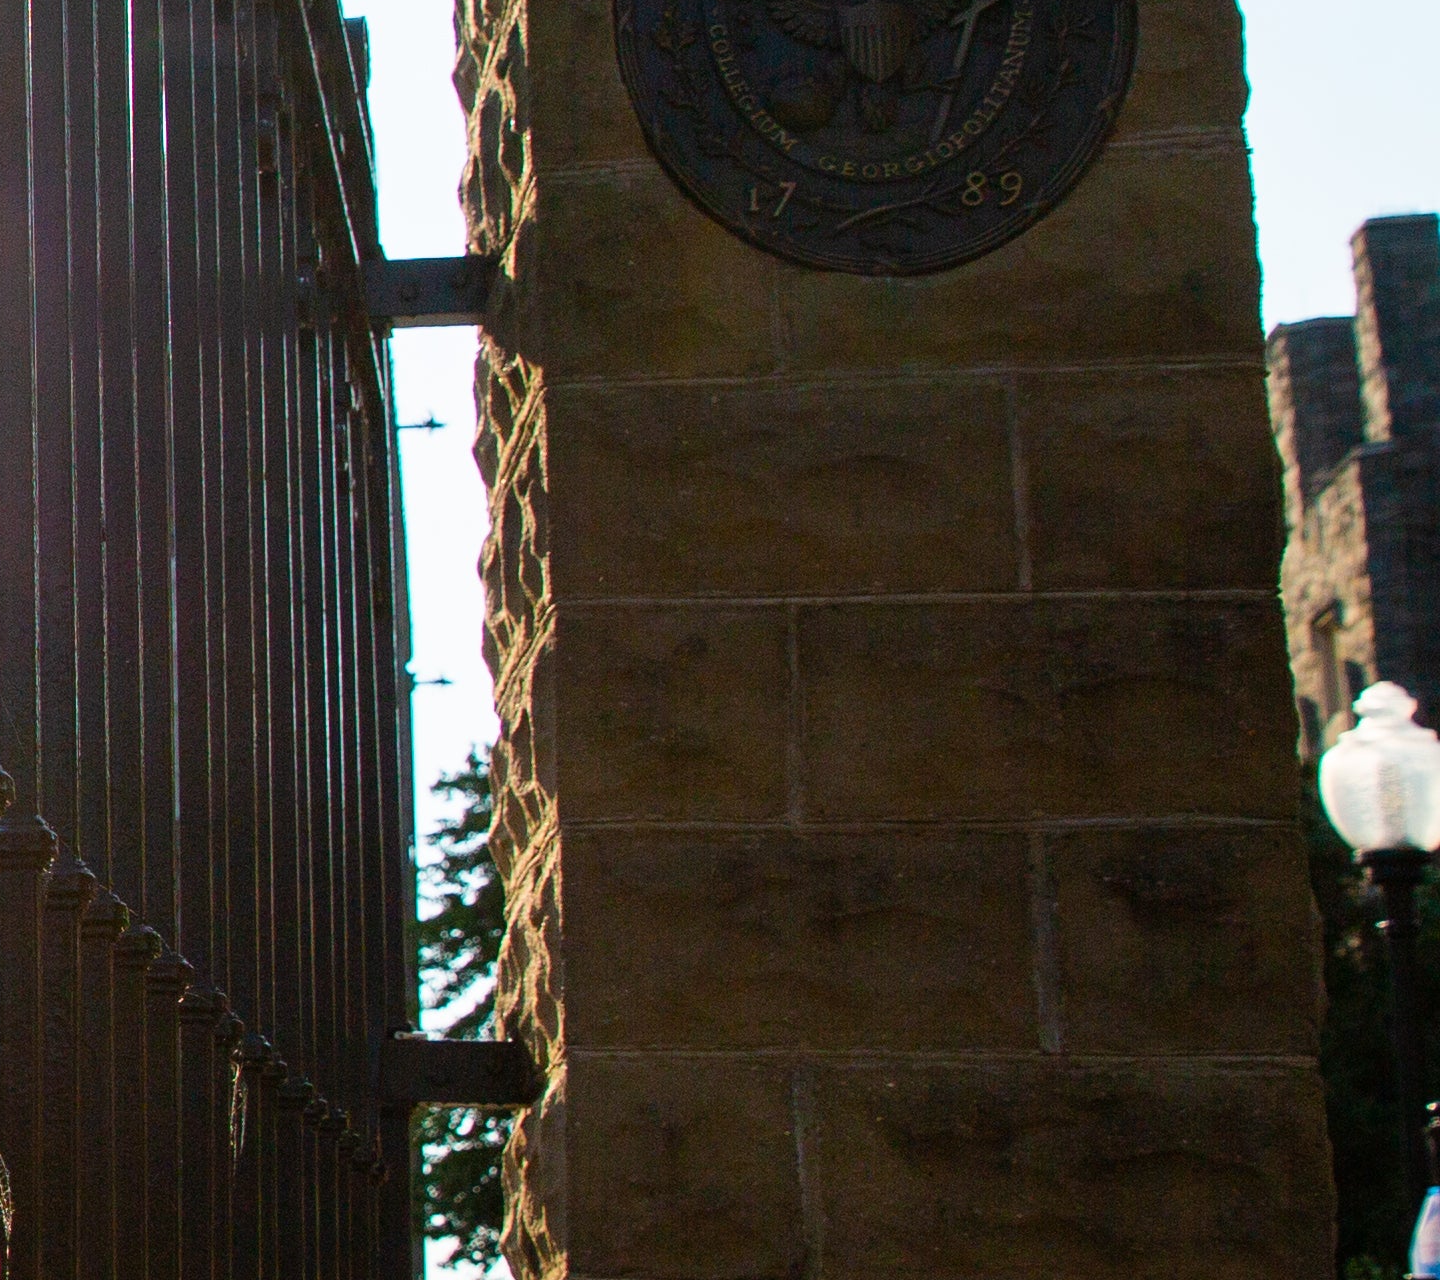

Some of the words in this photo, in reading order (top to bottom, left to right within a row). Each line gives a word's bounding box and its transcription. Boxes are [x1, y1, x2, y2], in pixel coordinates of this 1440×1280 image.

[709, 24, 799, 152] COLLEGIUM
[748, 181, 798, 218] 17
[961, 170, 1023, 207] 89
